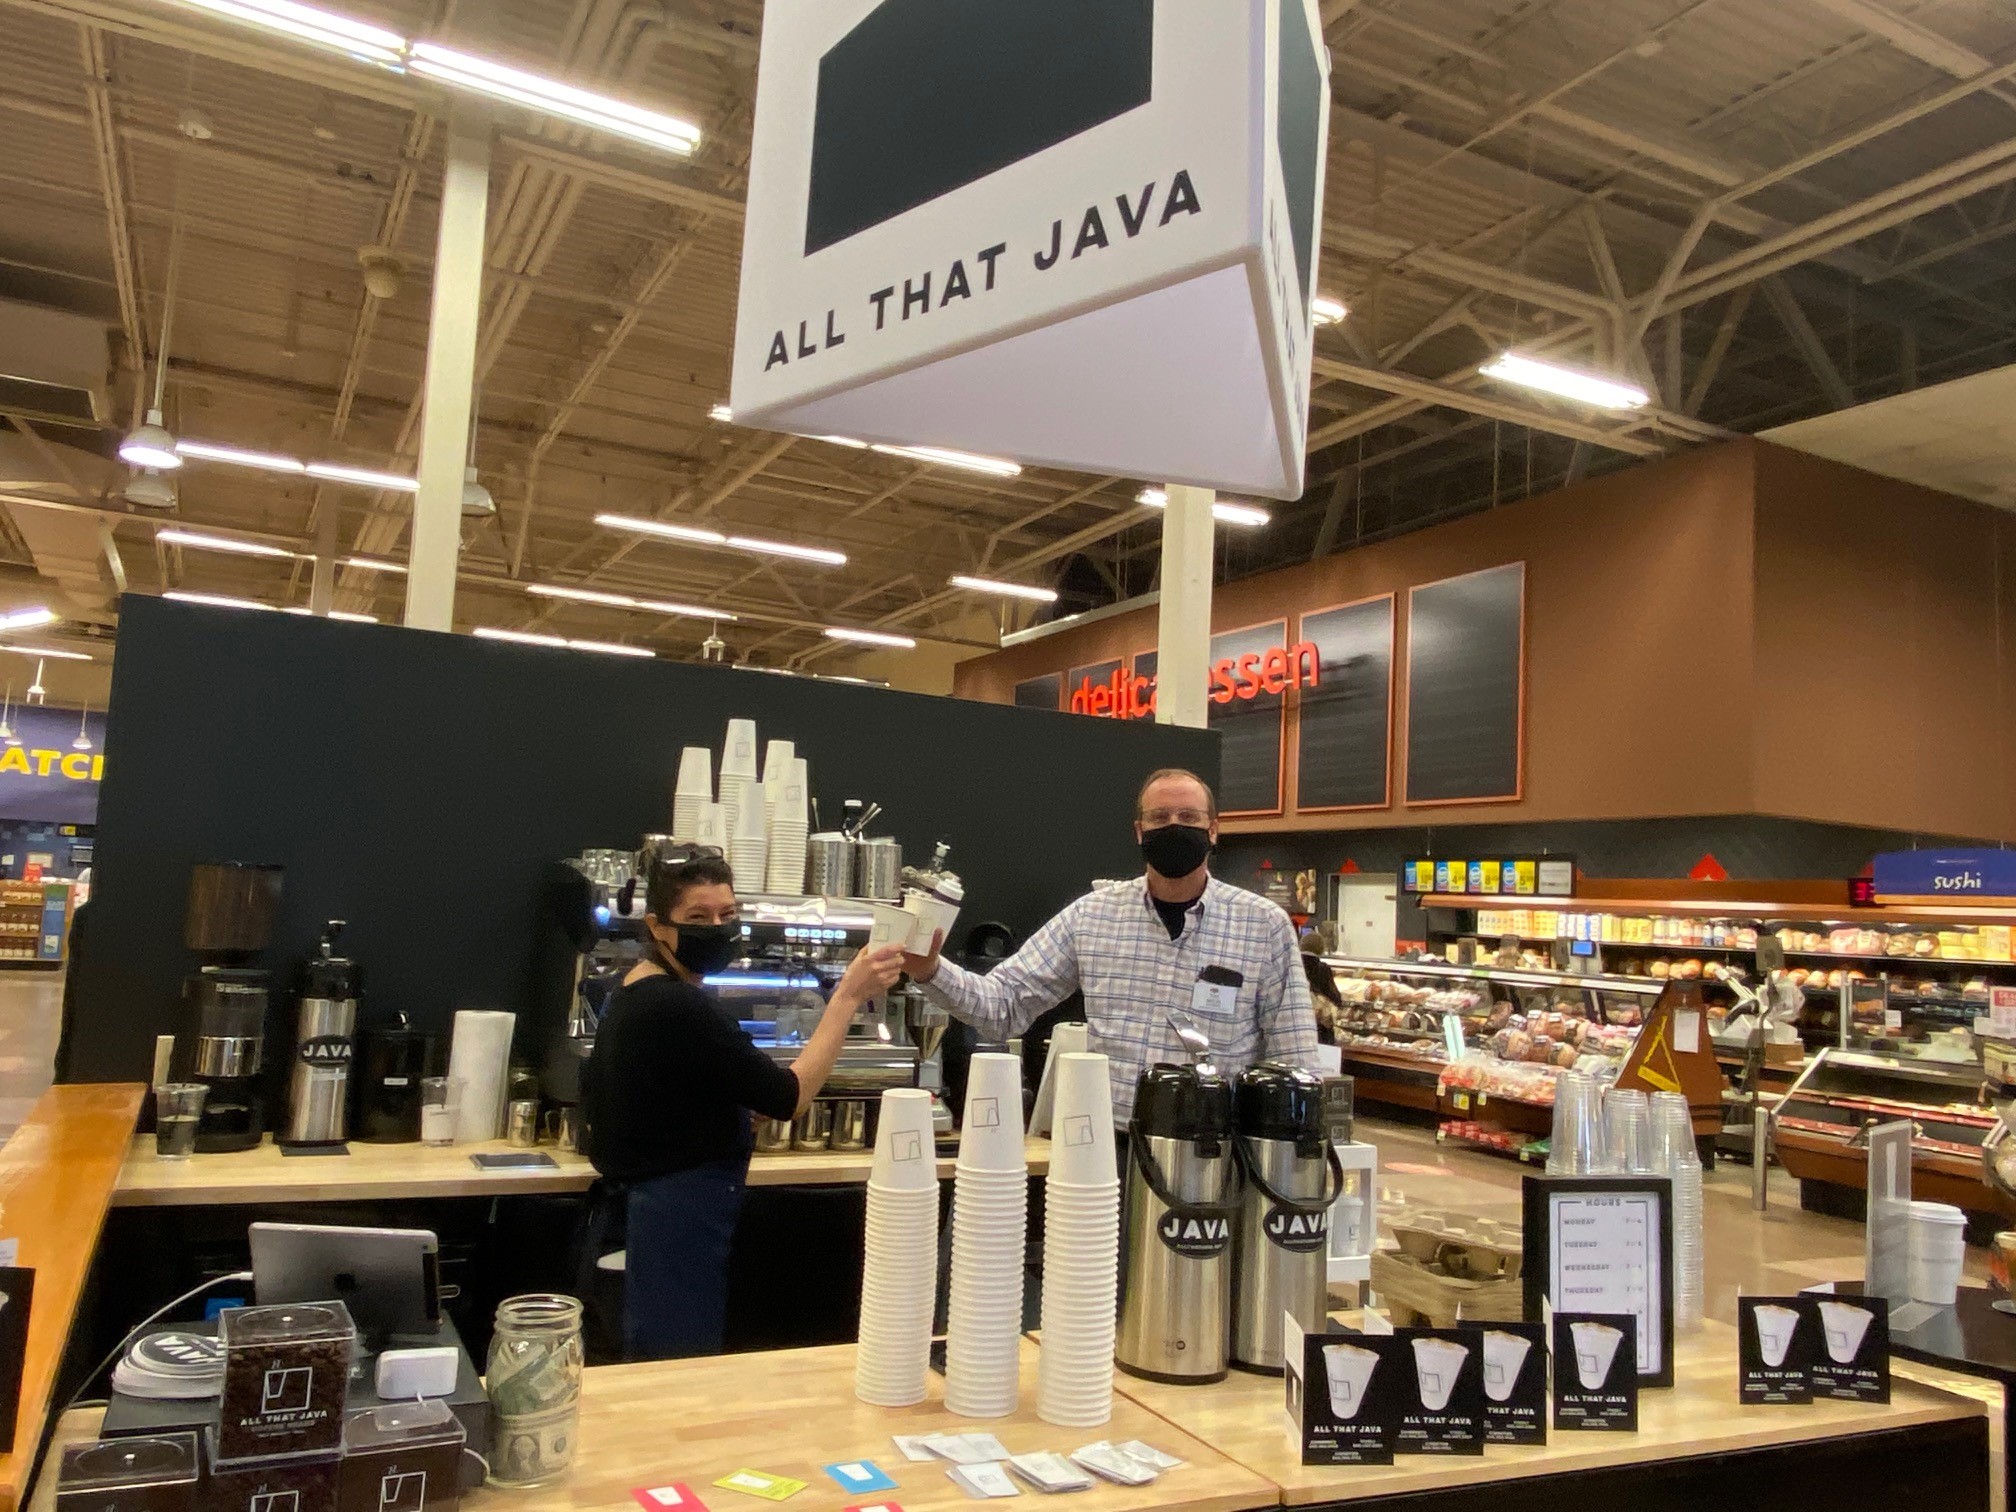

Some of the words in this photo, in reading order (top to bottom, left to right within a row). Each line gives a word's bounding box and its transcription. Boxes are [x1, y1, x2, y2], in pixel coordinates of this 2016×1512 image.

[764, 308, 846, 373] ALL
[868, 241, 1007, 331] THAT
[1032, 168, 1202, 271] JAVA
[1934, 871, 1982, 889] sushi
[303, 1044, 351, 1058] JAVA
[1586, 1198, 1621, 1207] HOURS
[1269, 1211, 1328, 1235] JAVA
[1564, 1218, 1596, 1226] MONDAY
[1164, 1217, 1229, 1240] JAVA
[1564, 1240, 1598, 1249] TUESDAY
[1563, 1395, 1579, 1403] ALL
[1582, 1395, 1604, 1403] THAT
[1487, 1407, 1510, 1415] THAT
[1512, 1407, 1536, 1416] JAVA
[239, 1416, 262, 1426] ALL
[266, 1412, 295, 1424] THAT
[299, 1409, 329, 1420] JAVA
[1403, 1416, 1421, 1424] ALL
[1423, 1416, 1447, 1425] THAT
[1449, 1417, 1472, 1426] JAVA
[1313, 1425, 1331, 1434] ALL
[1333, 1425, 1357, 1433] THAT
[1359, 1426, 1382, 1434] JAVA
